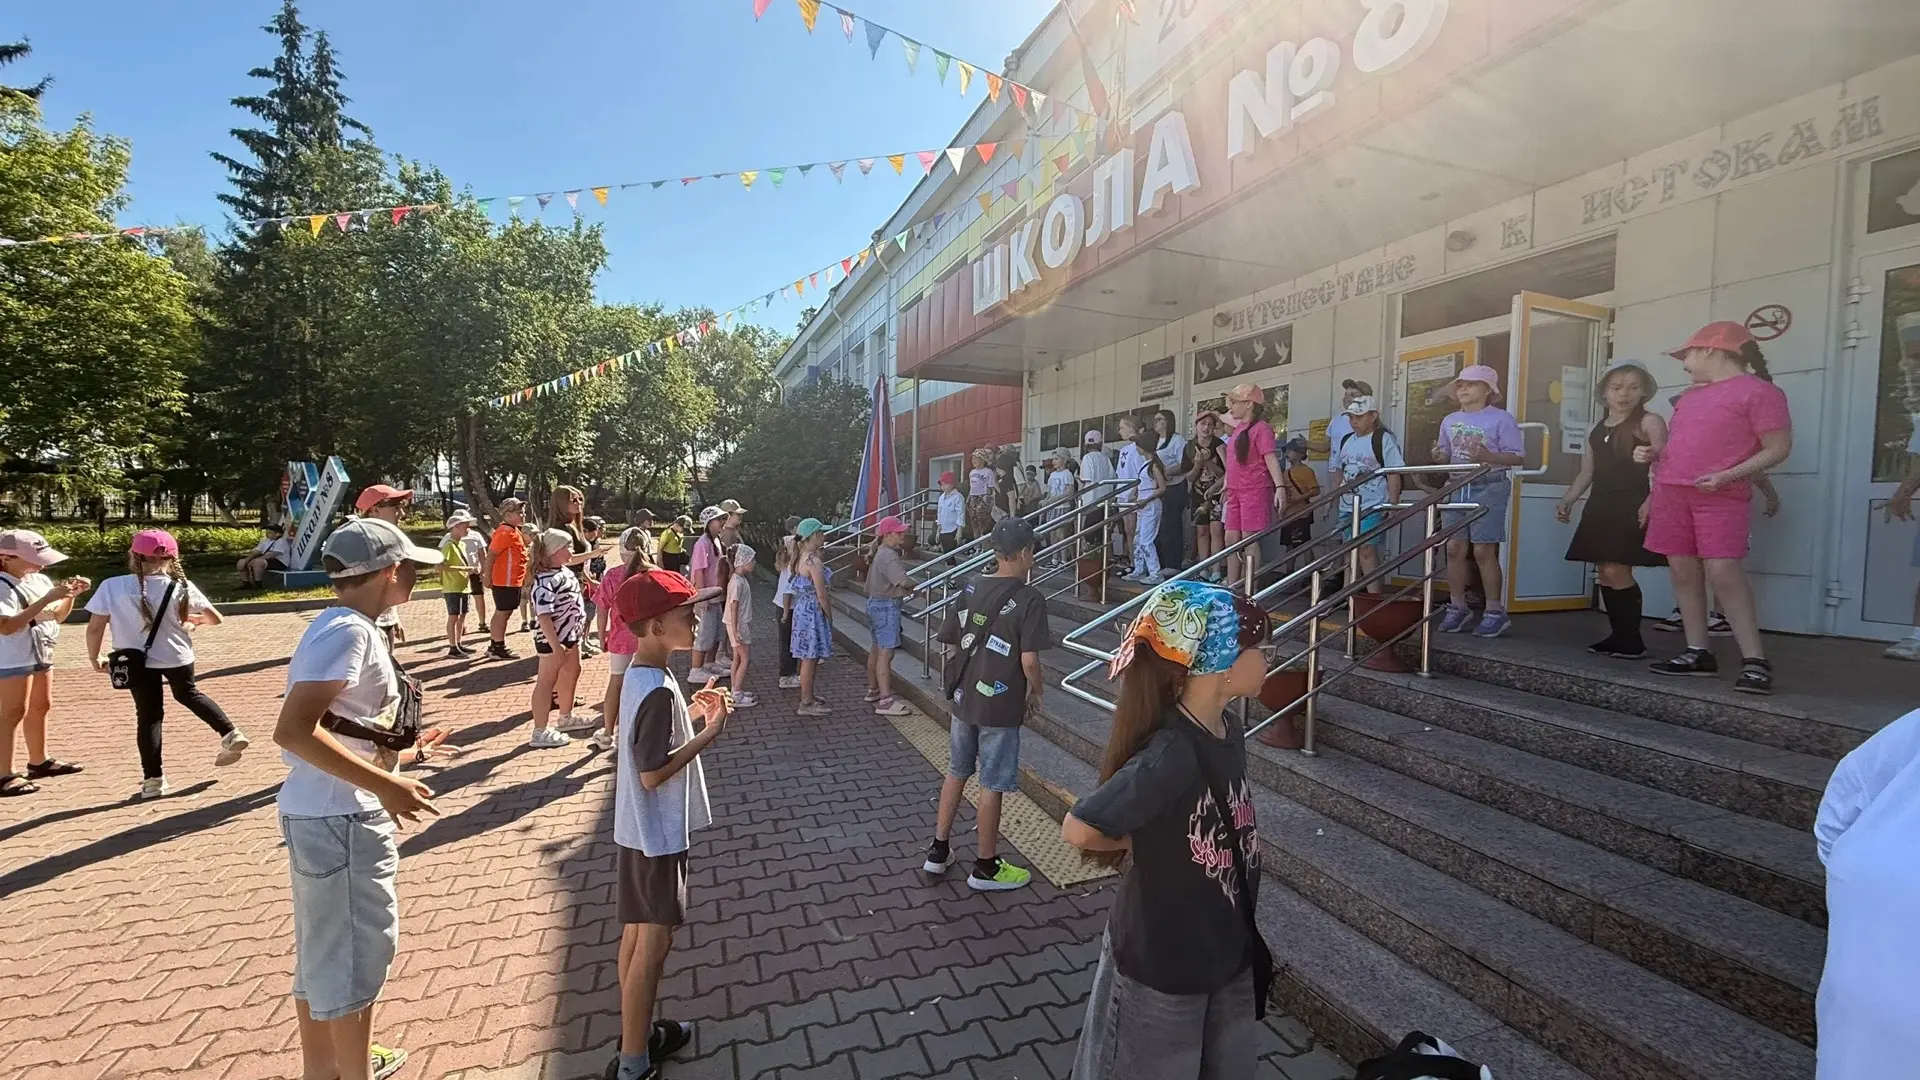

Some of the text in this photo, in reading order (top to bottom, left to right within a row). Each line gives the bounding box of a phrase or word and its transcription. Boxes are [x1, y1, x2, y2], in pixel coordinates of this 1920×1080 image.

[973, 110, 1200, 316] ШКОЛА
[1499, 213, 1529, 250] К
[1581, 95, 1886, 225] ИСТОКАМ
[296, 499, 322, 557] ШКОЛУ
